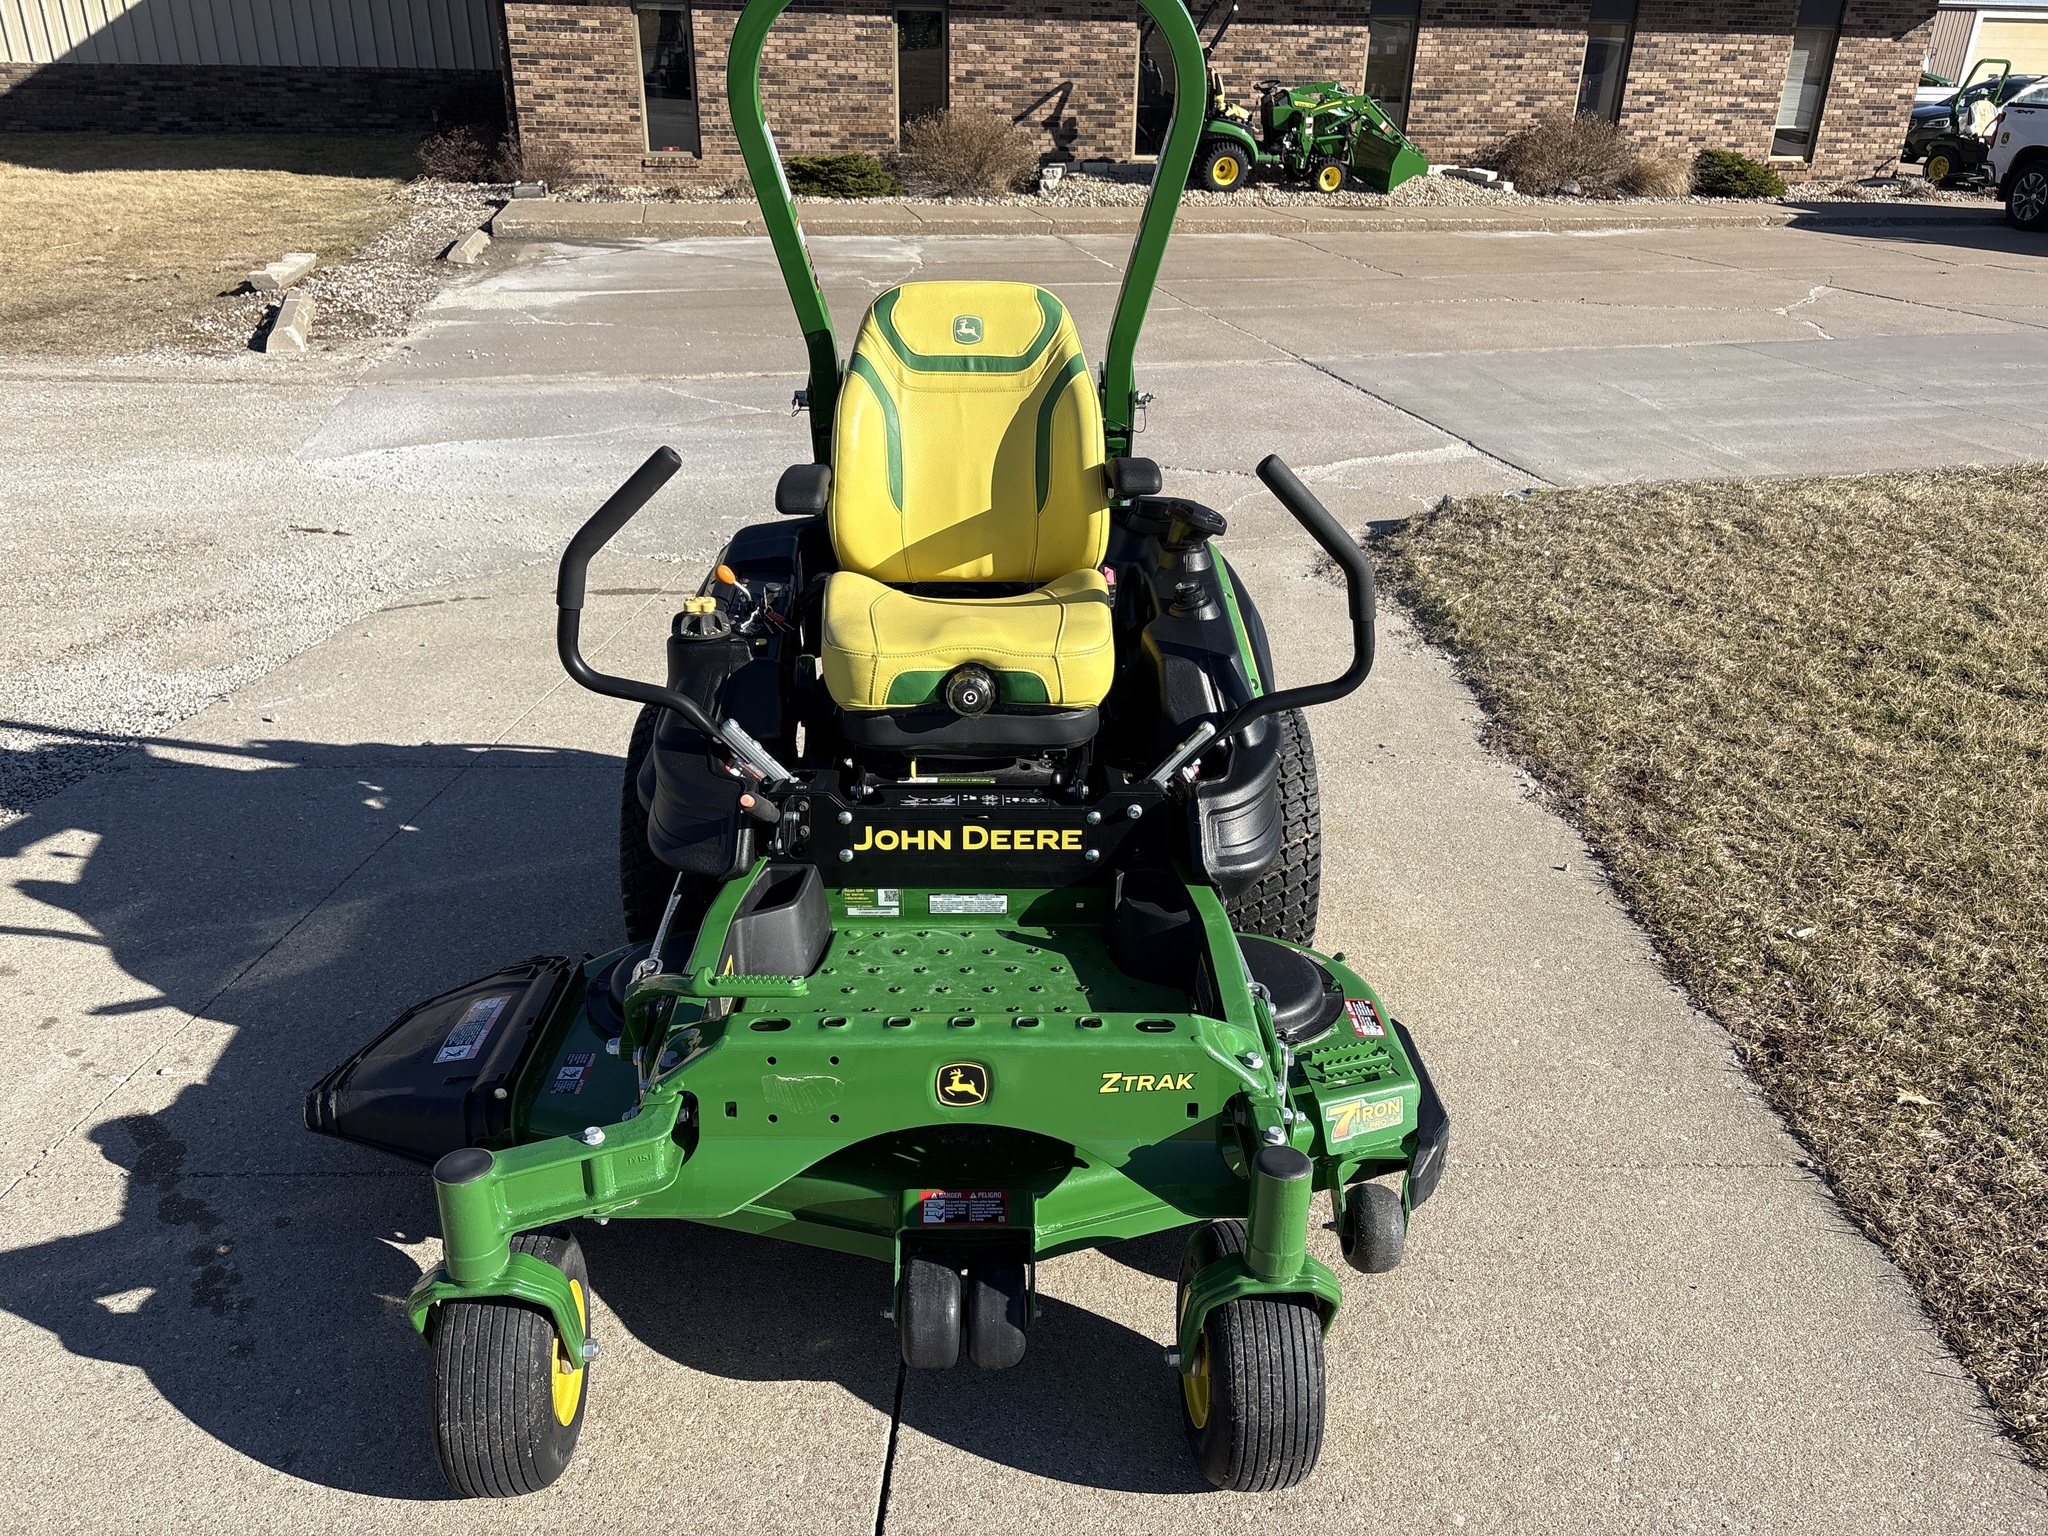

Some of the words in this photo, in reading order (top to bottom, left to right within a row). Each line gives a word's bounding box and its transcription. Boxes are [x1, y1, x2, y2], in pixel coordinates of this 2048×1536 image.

[853, 825, 952, 851] JOHN
[962, 825, 1083, 851] DEERE
[1099, 1071, 1198, 1094] ZTRAK
[1355, 1098, 1401, 1124] IRON
[1369, 1120, 1387, 1129] PRO
